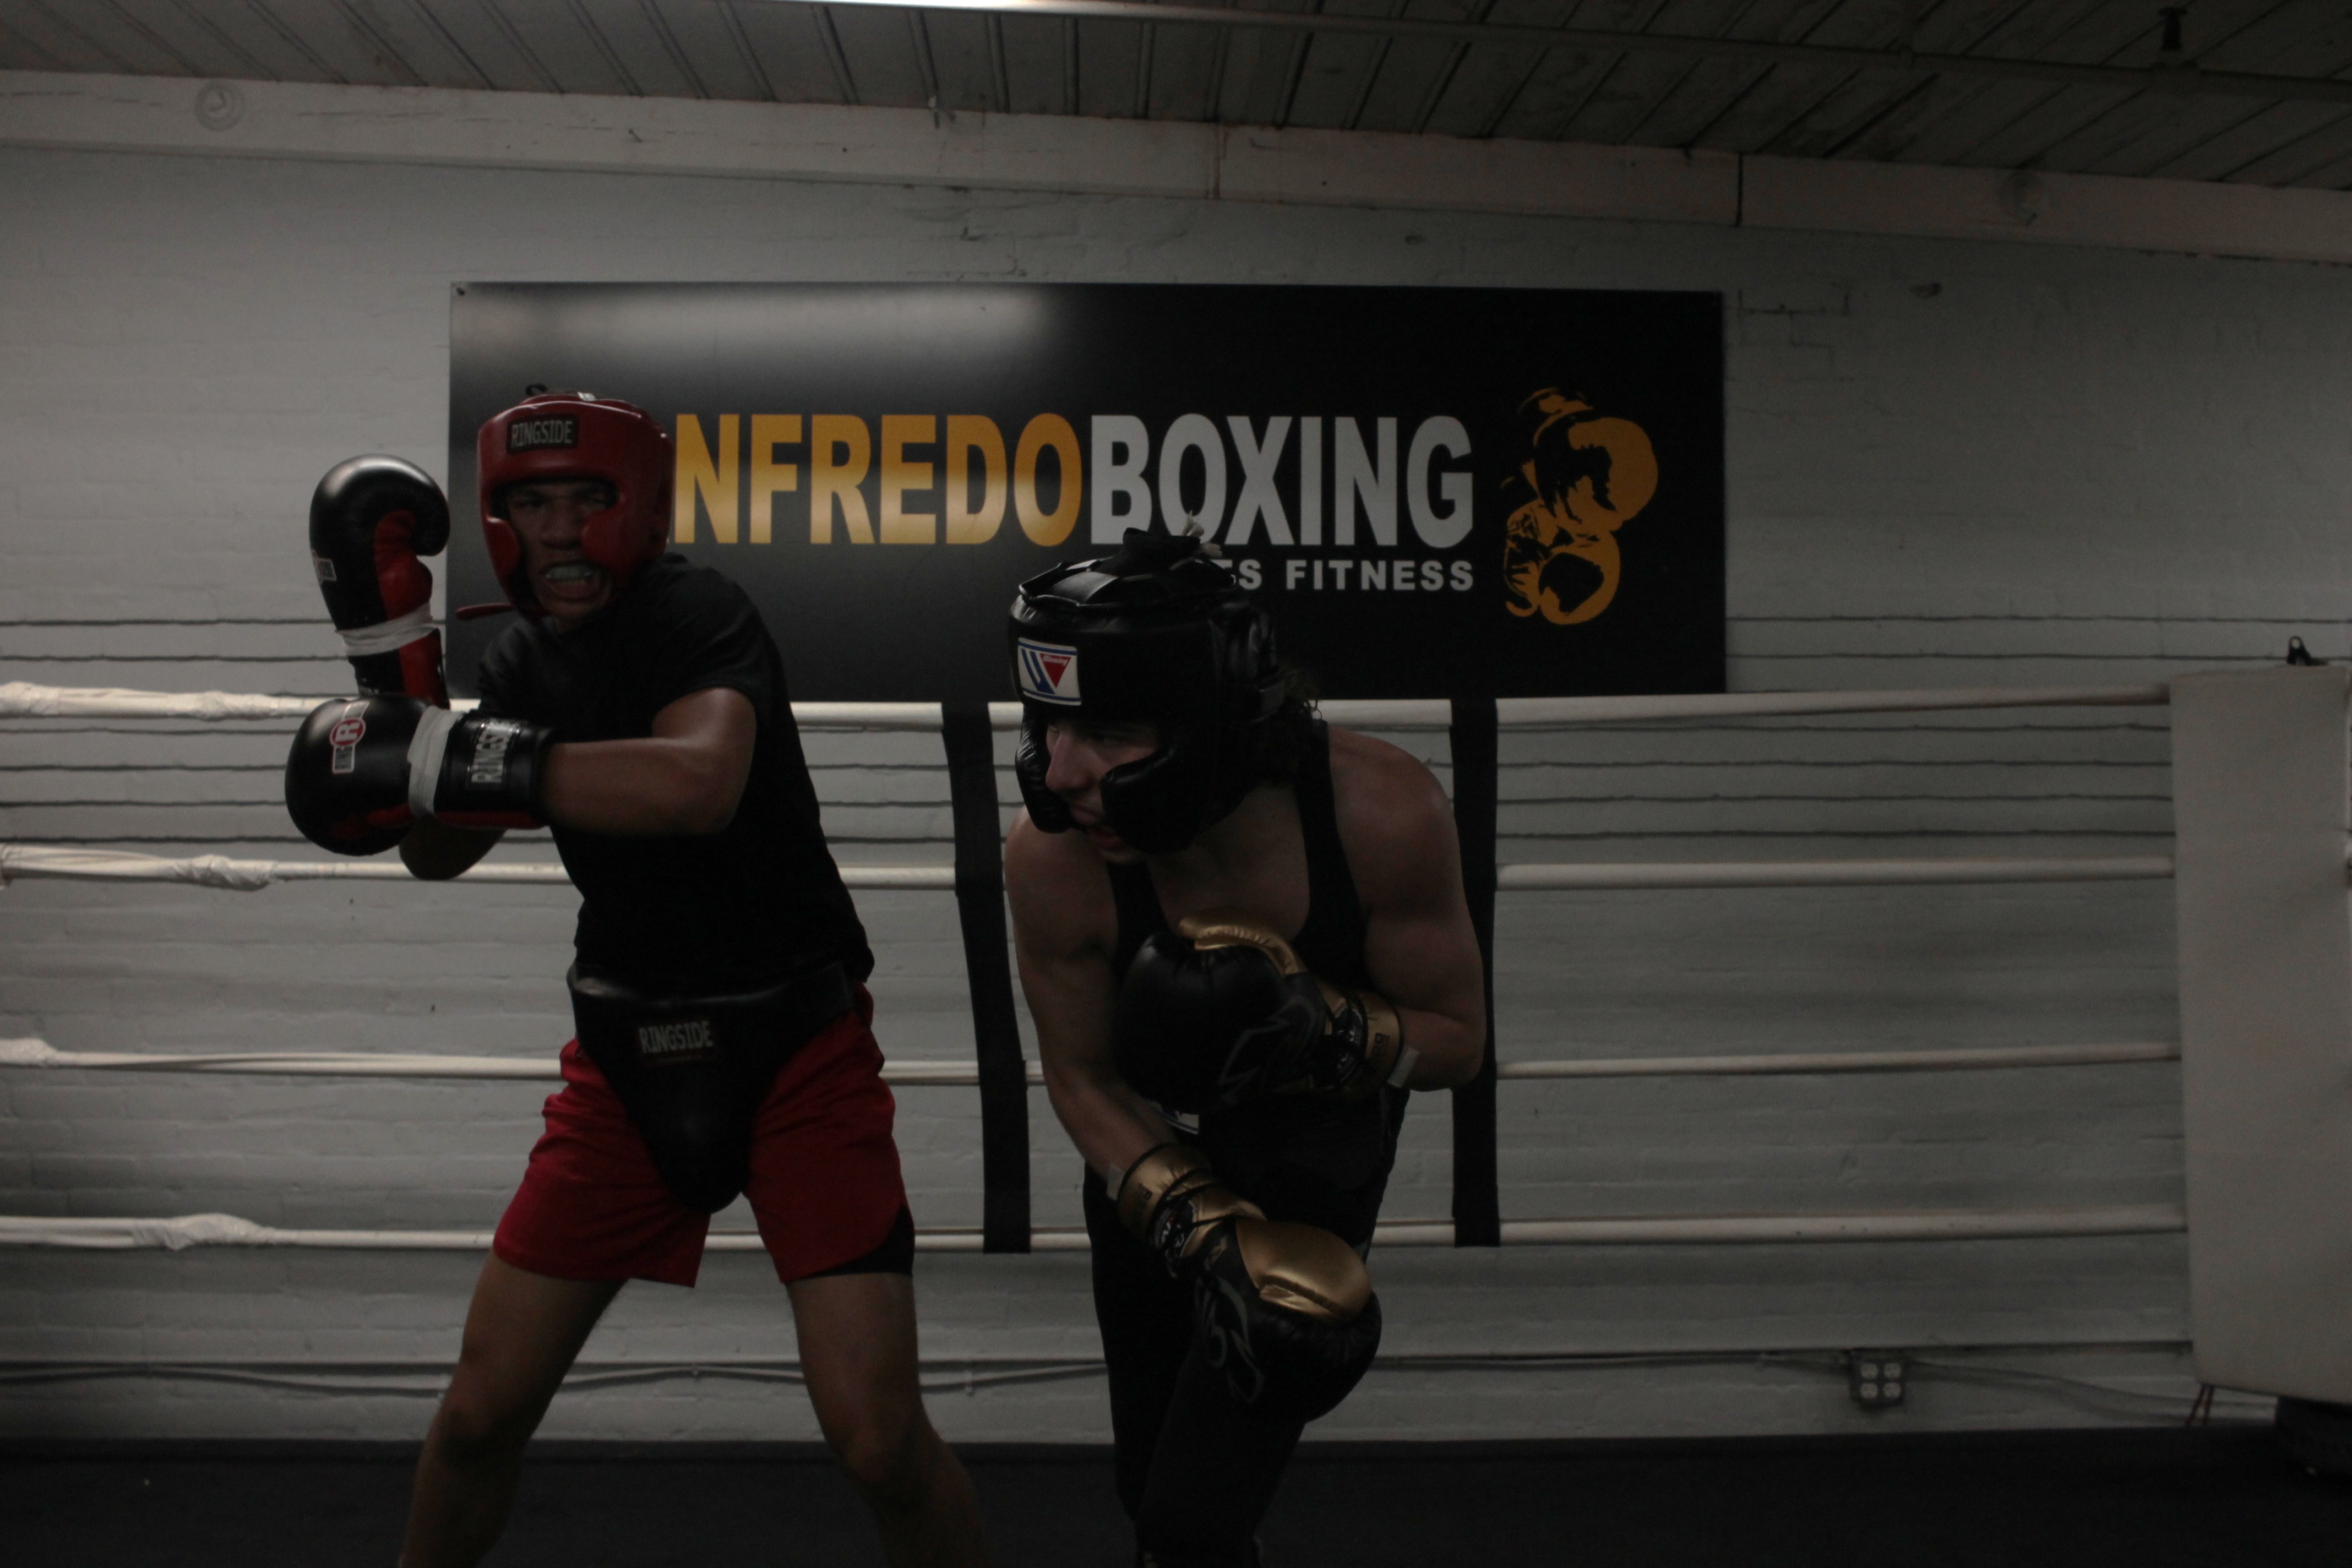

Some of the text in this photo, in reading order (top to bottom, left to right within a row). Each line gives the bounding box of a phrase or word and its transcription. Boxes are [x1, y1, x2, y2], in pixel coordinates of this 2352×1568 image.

[511, 419, 574, 449] RINGSIDE
[1286, 558, 1474, 591] FITNESS
[639, 1020, 714, 1054] RINGSIDE
